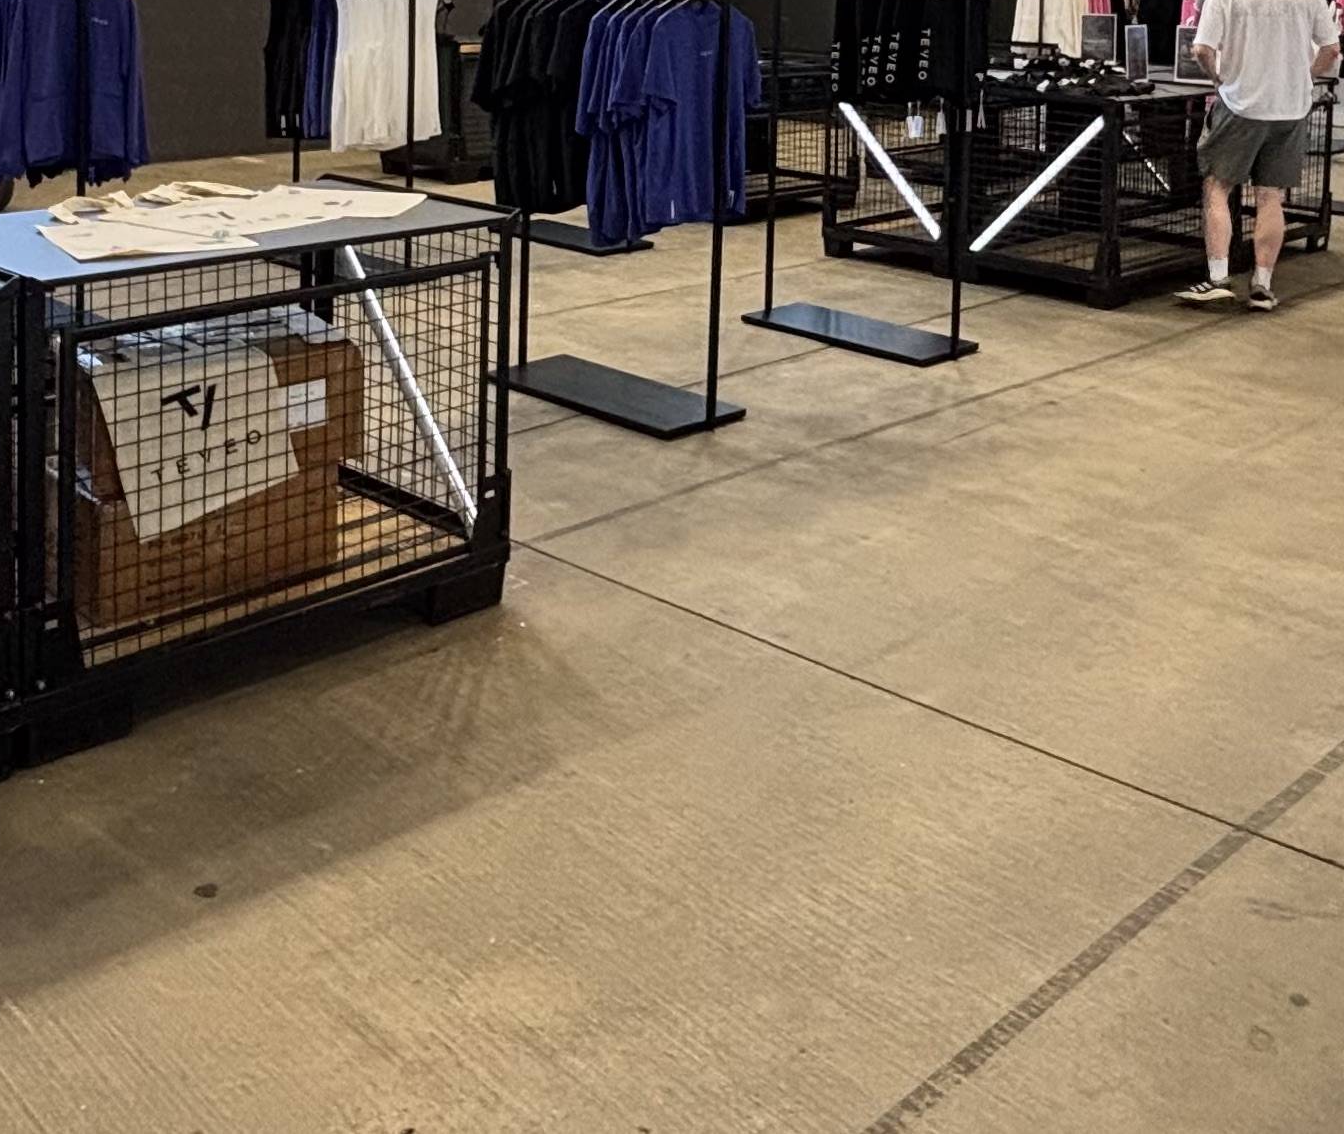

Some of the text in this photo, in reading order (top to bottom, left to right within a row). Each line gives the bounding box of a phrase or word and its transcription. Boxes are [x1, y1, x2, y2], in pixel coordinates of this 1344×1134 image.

[884, 31, 901, 84] TEVEO
[917, 27, 932, 81] TEVEO
[150, 429, 262, 484] TEVEO
